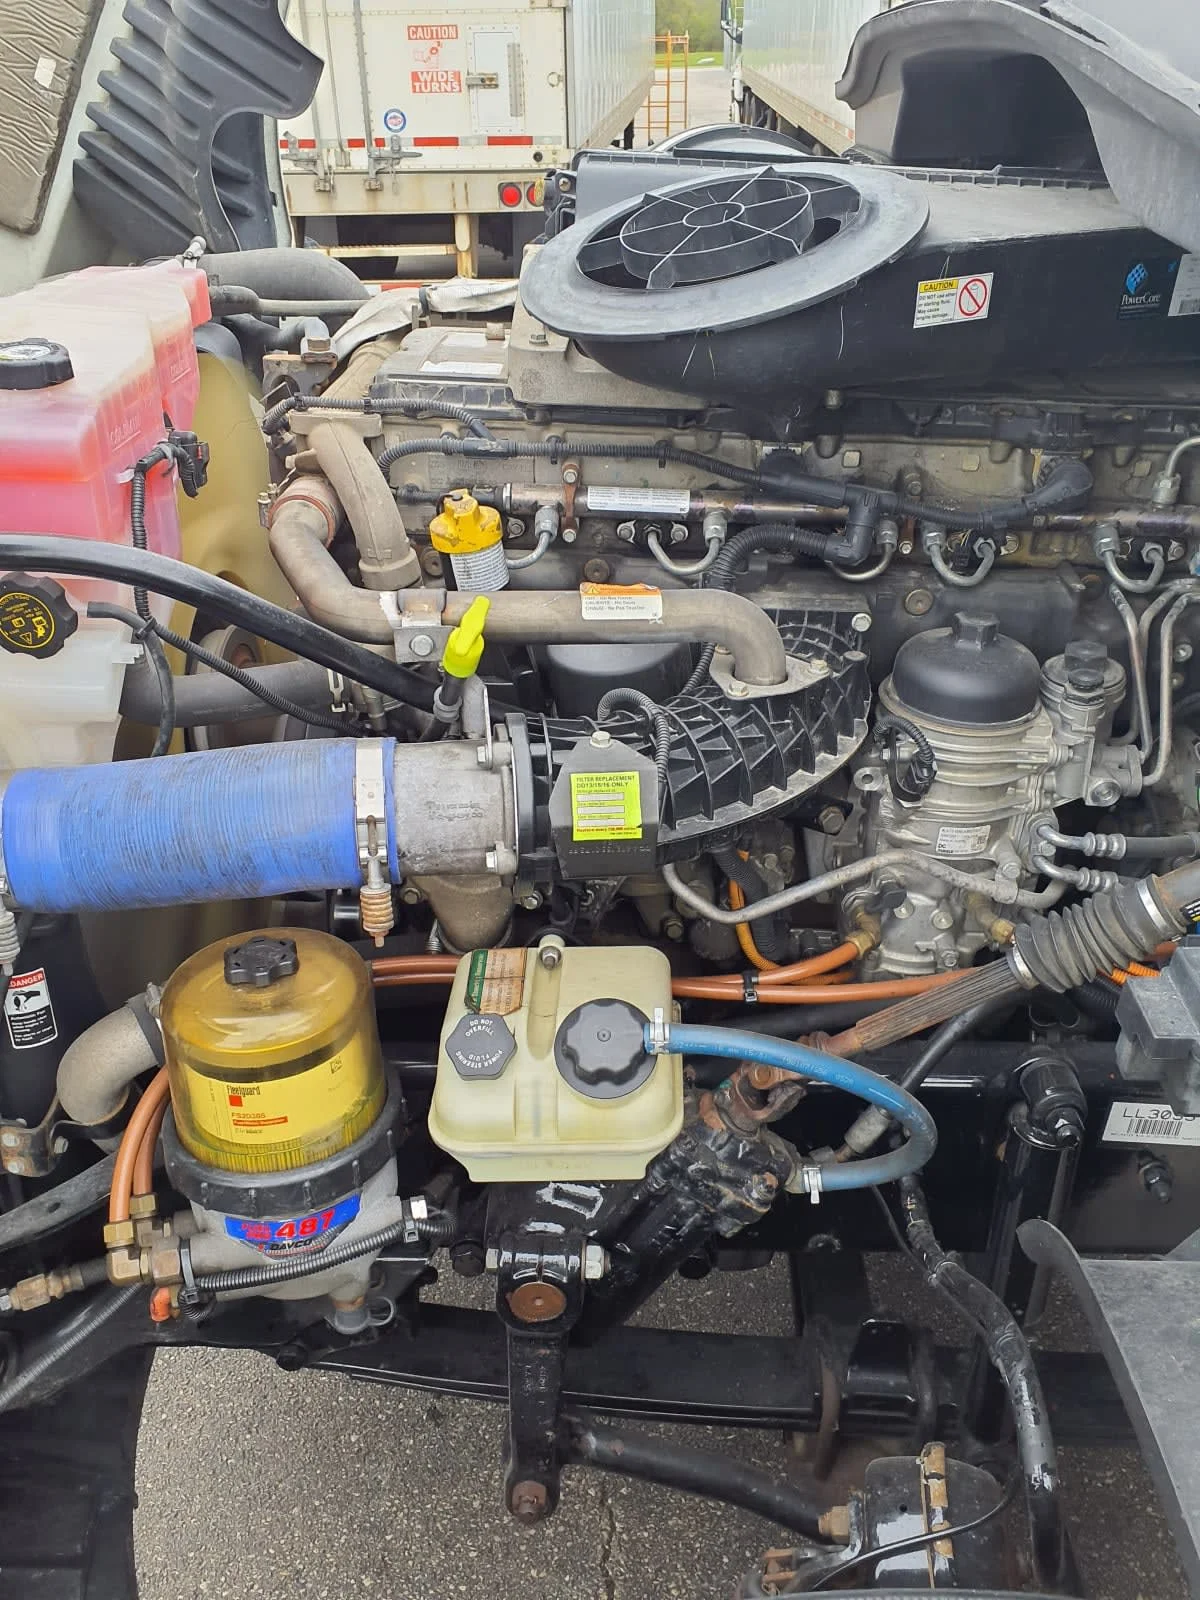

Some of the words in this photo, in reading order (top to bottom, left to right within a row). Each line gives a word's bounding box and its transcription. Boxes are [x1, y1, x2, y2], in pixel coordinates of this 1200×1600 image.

[408, 26, 457, 39] CAUTION
[417, 71, 455, 82] WIDE
[413, 81, 461, 93] TURNS
[923, 281, 954, 291] CAUTION
[1120, 291, 1161, 306] PowerCore
[9, 973, 44, 988] DANGER
[469, 1019, 479, 1027] DO
[480, 1018, 494, 1027] NOT
[465, 1025, 494, 1038] OVERFILL
[455, 1050, 482, 1069] STEERING
[468, 1053, 490, 1061] FLUID
[484, 1049, 504, 1068] POWER
[226, 1085, 261, 1098] Fleetguard
[269, 1238, 313, 1251] DAVCO
